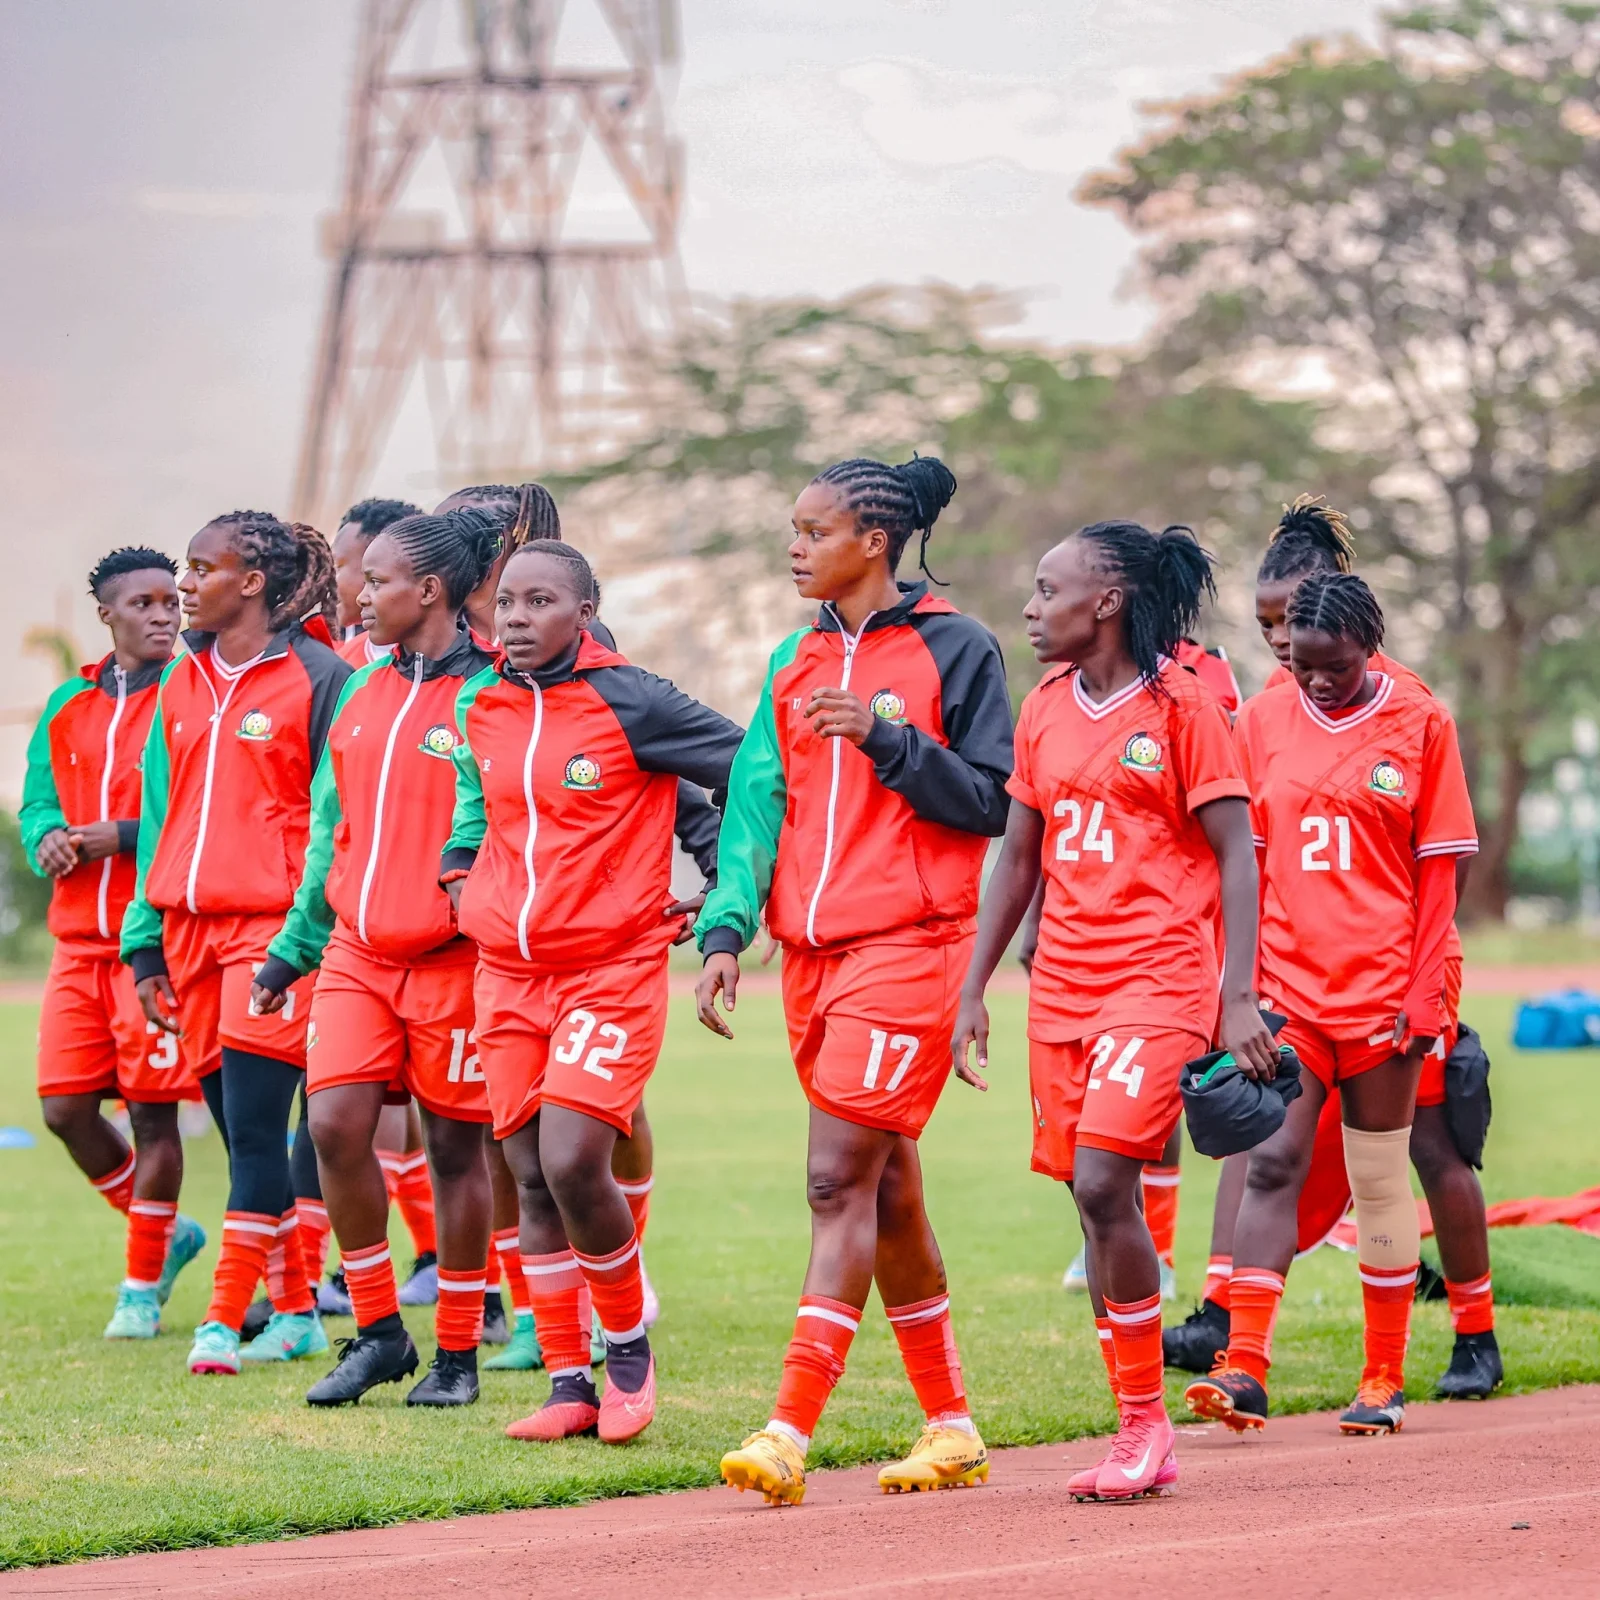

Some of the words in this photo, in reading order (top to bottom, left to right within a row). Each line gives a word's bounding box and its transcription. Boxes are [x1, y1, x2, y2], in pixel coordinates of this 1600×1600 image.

[1053, 799, 1114, 863] 24
[1300, 815, 1351, 871] 21
[146, 1020, 179, 1069] 3
[555, 1009, 628, 1082] 32
[863, 1028, 919, 1092] 17
[1087, 1034, 1146, 1099] 24
